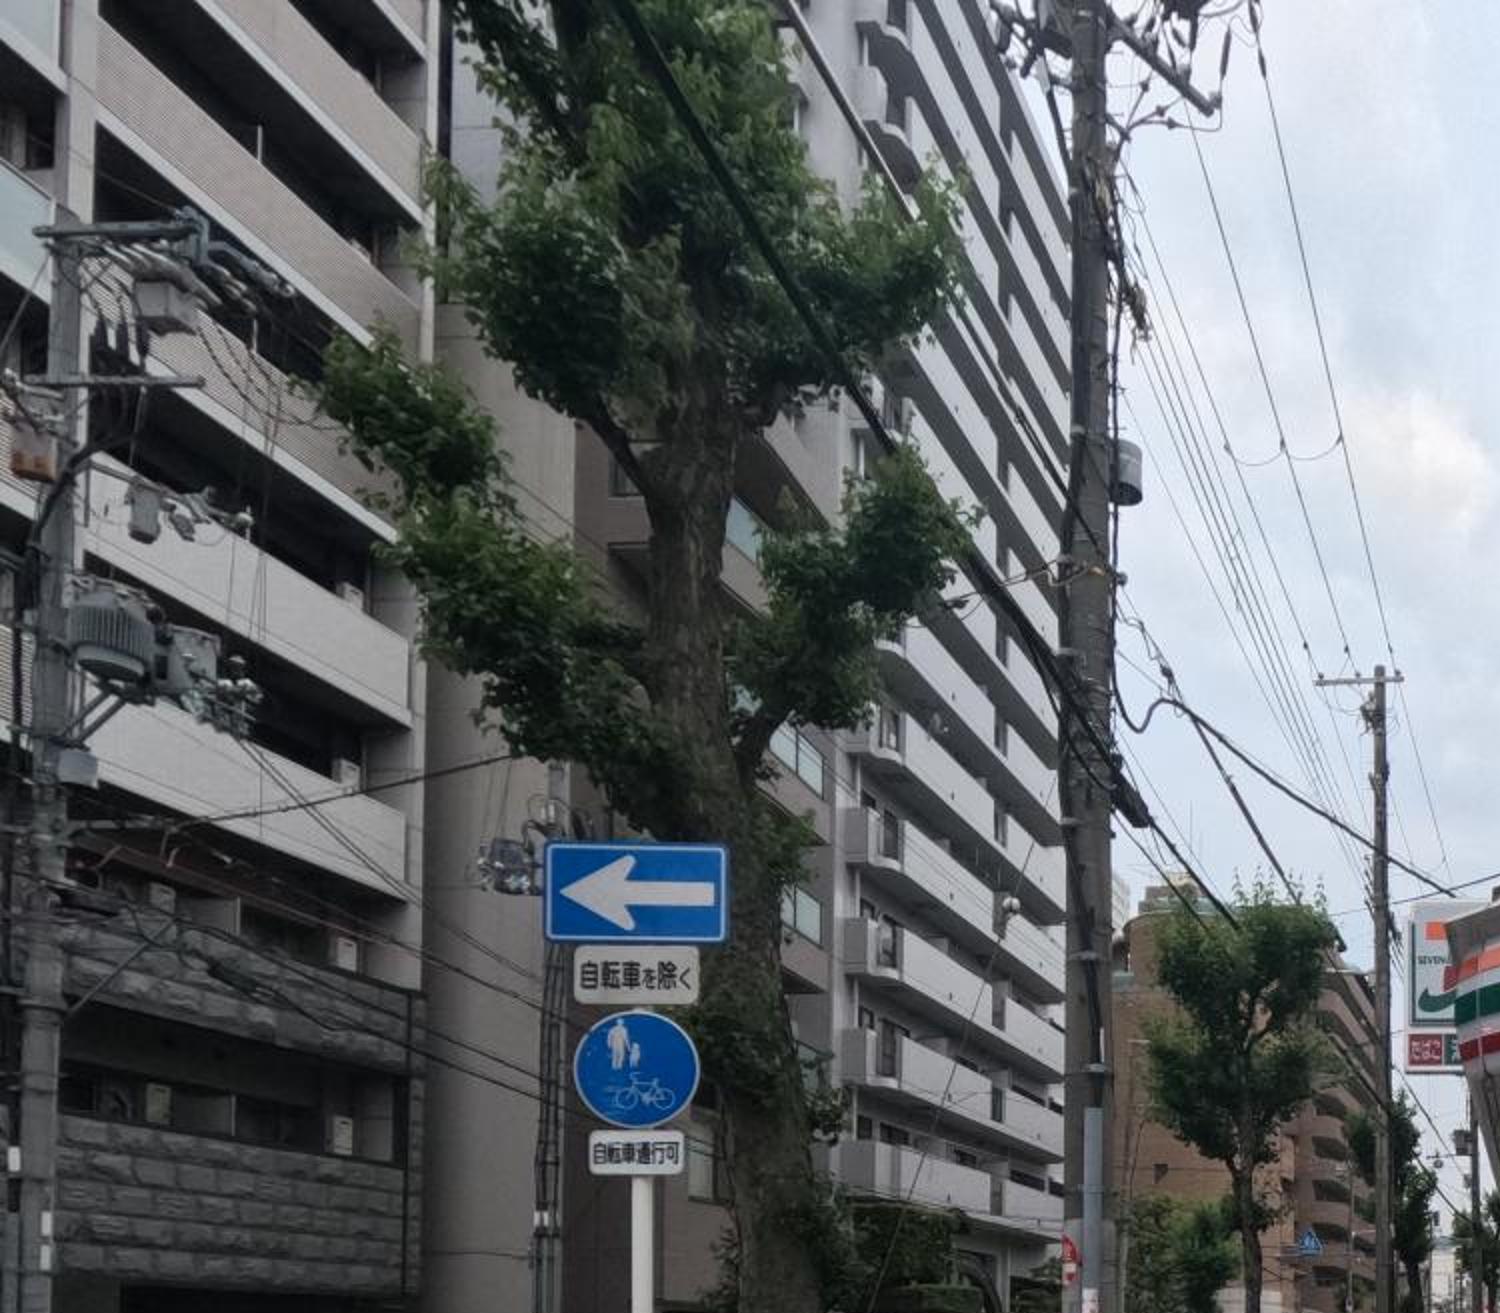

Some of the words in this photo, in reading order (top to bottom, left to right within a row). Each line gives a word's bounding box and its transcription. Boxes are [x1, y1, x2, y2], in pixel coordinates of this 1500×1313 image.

[579, 960, 693, 991] 自転車を除く
[592, 1141, 680, 1167] 自転車通行可
